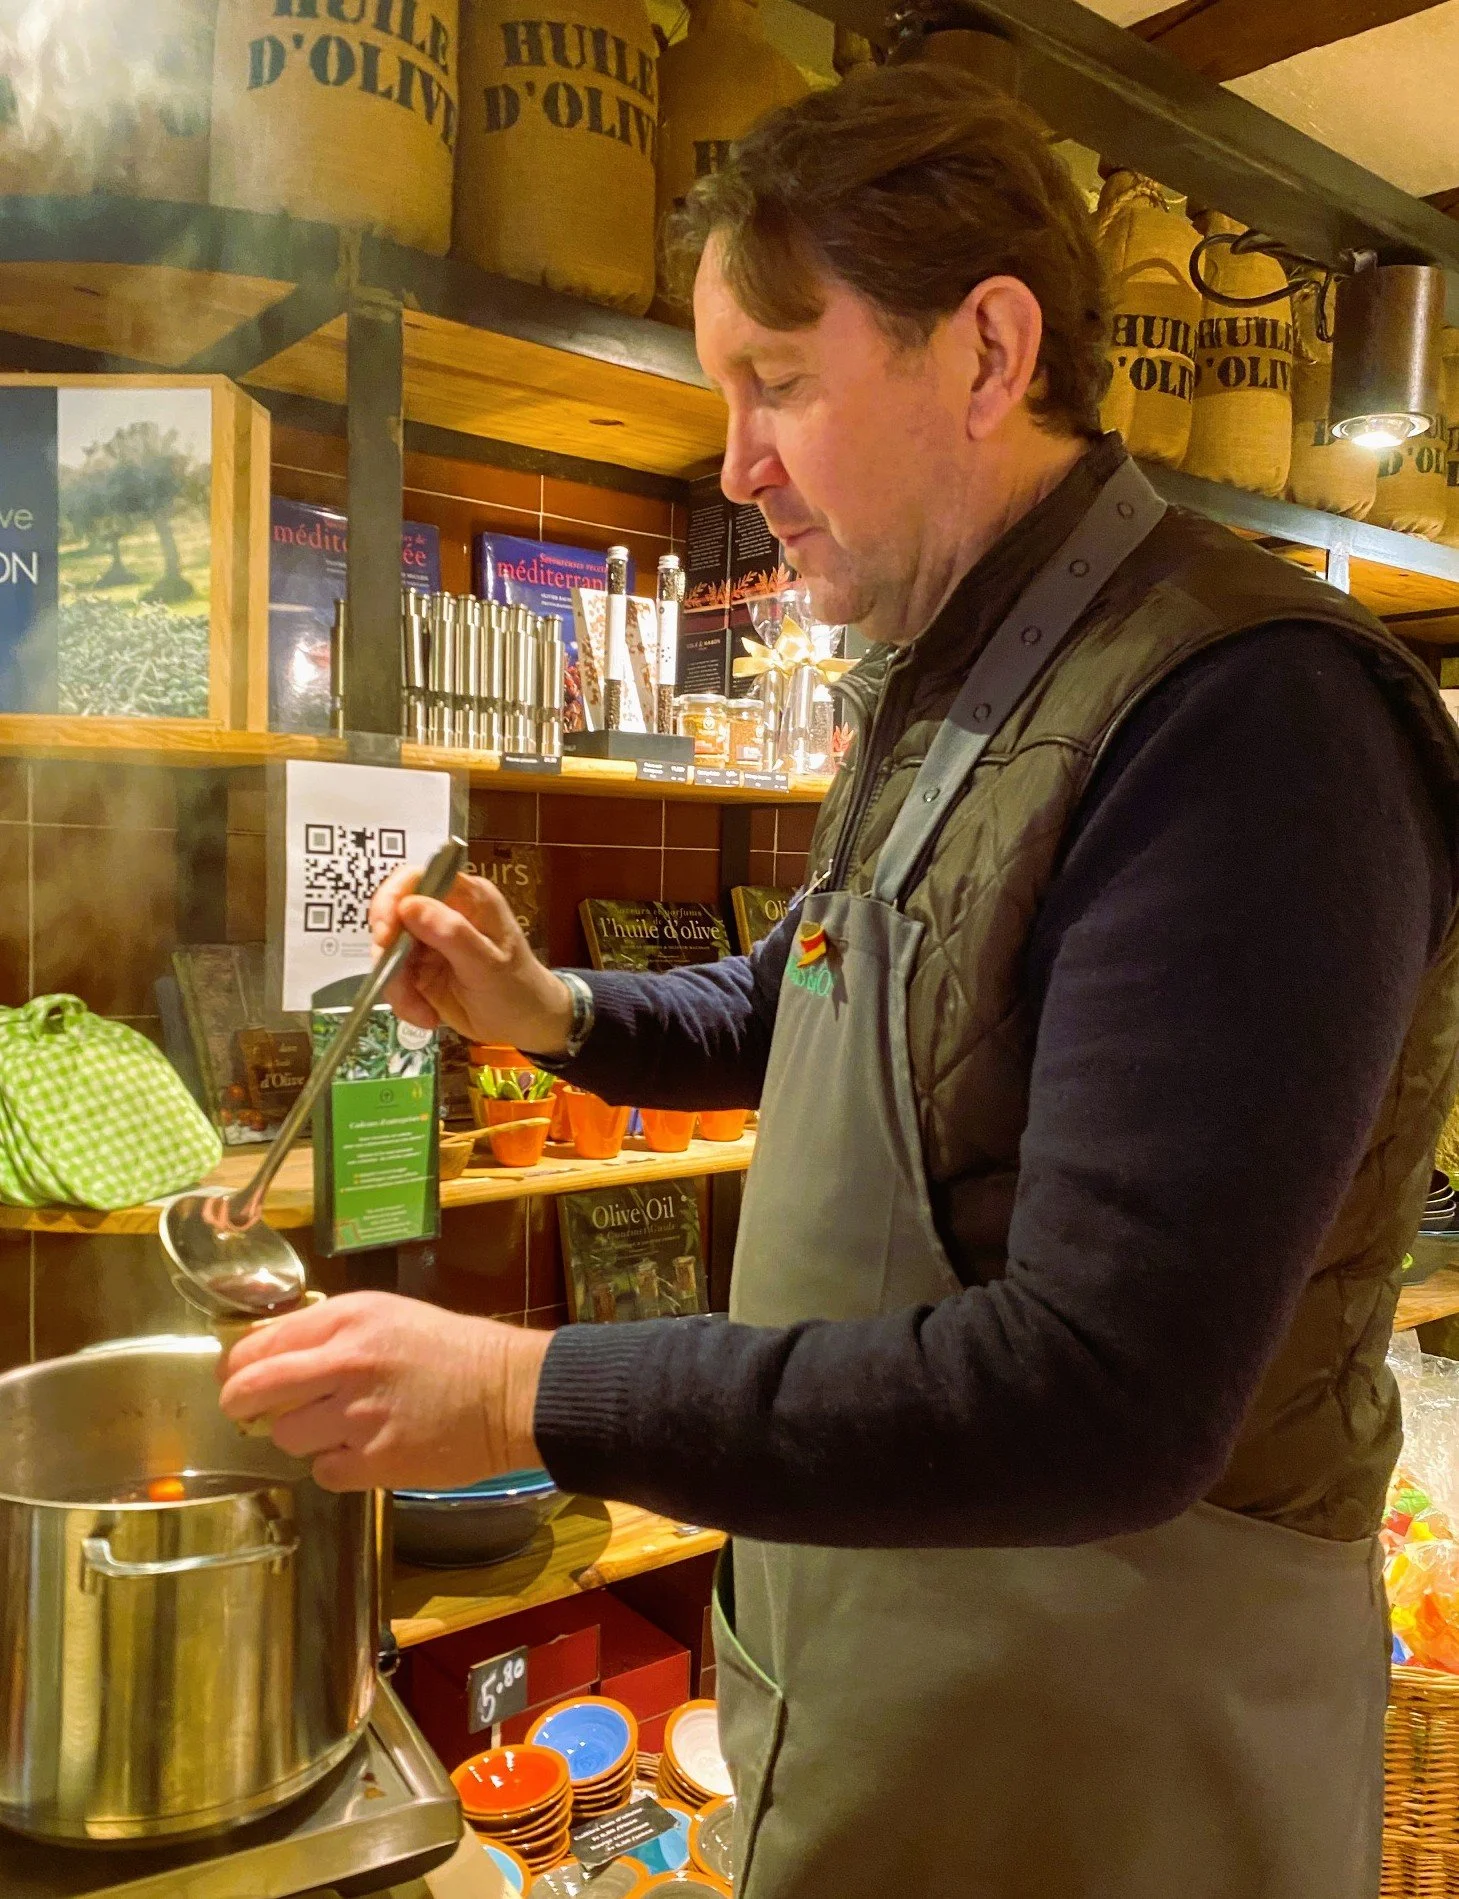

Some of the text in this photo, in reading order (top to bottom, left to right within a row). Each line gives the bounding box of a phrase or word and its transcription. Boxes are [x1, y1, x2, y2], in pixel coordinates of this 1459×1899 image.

[600, 918, 720, 940] l'huile d'olive
[592, 1204, 640, 1229] Olive
[646, 1196, 674, 1221] Oil
[477, 1657, 525, 1723] 5.80
